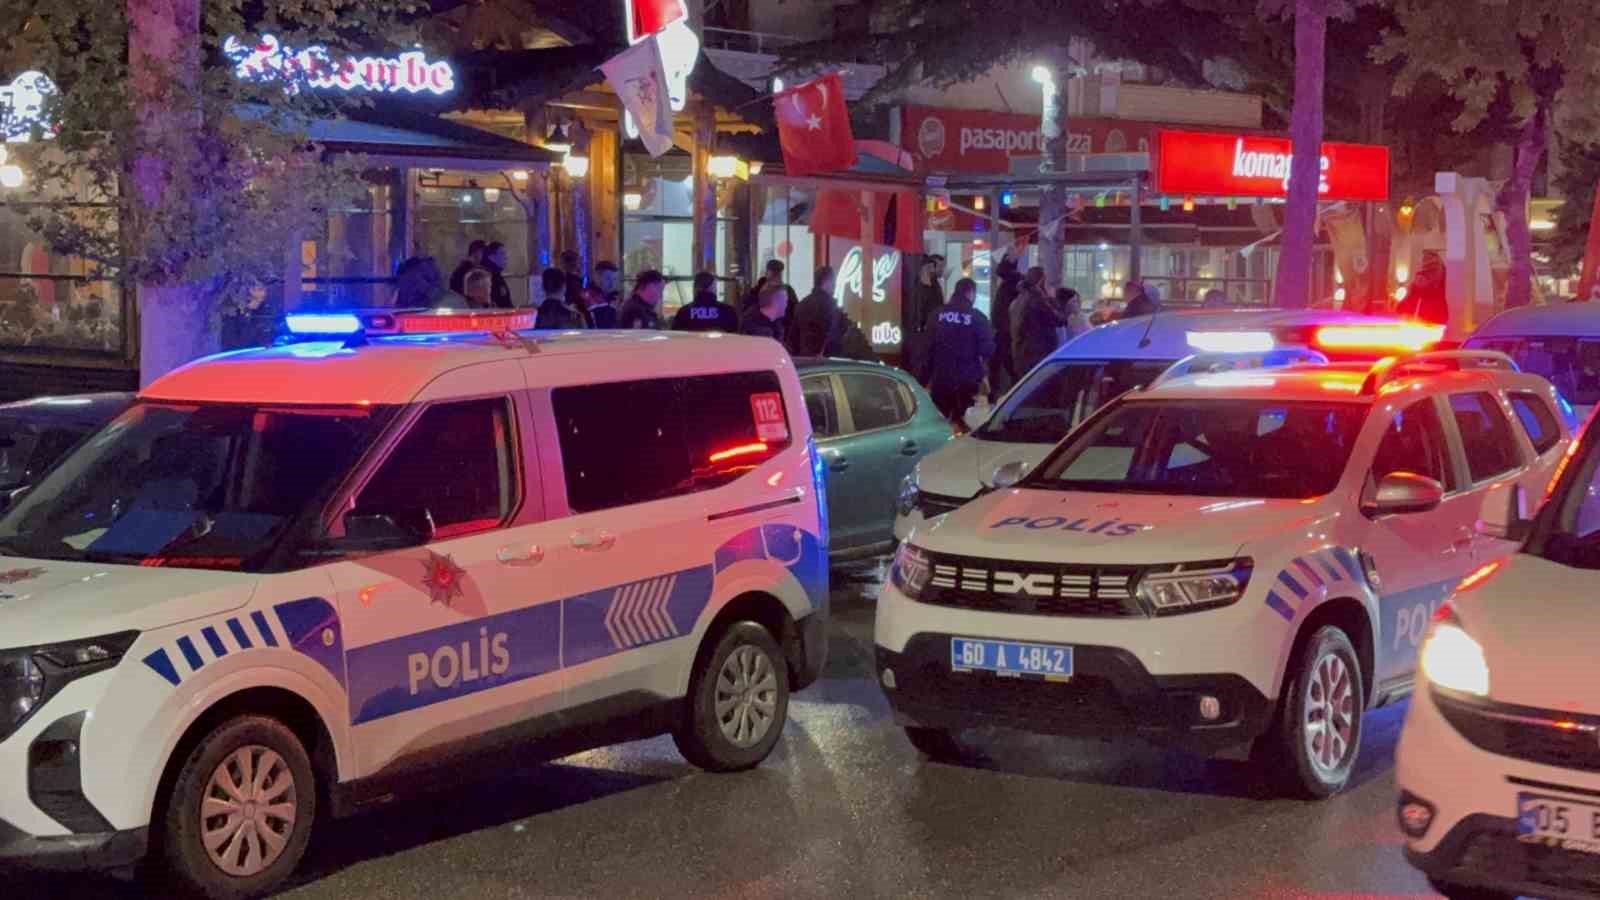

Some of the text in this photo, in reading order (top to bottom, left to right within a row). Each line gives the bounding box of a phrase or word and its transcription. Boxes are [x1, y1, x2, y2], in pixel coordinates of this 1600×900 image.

[755, 399, 780, 421] 112
[407, 625, 510, 696] POLİS
[963, 642, 1065, 673] 60 A 4842
[1535, 804, 1569, 834] 05
